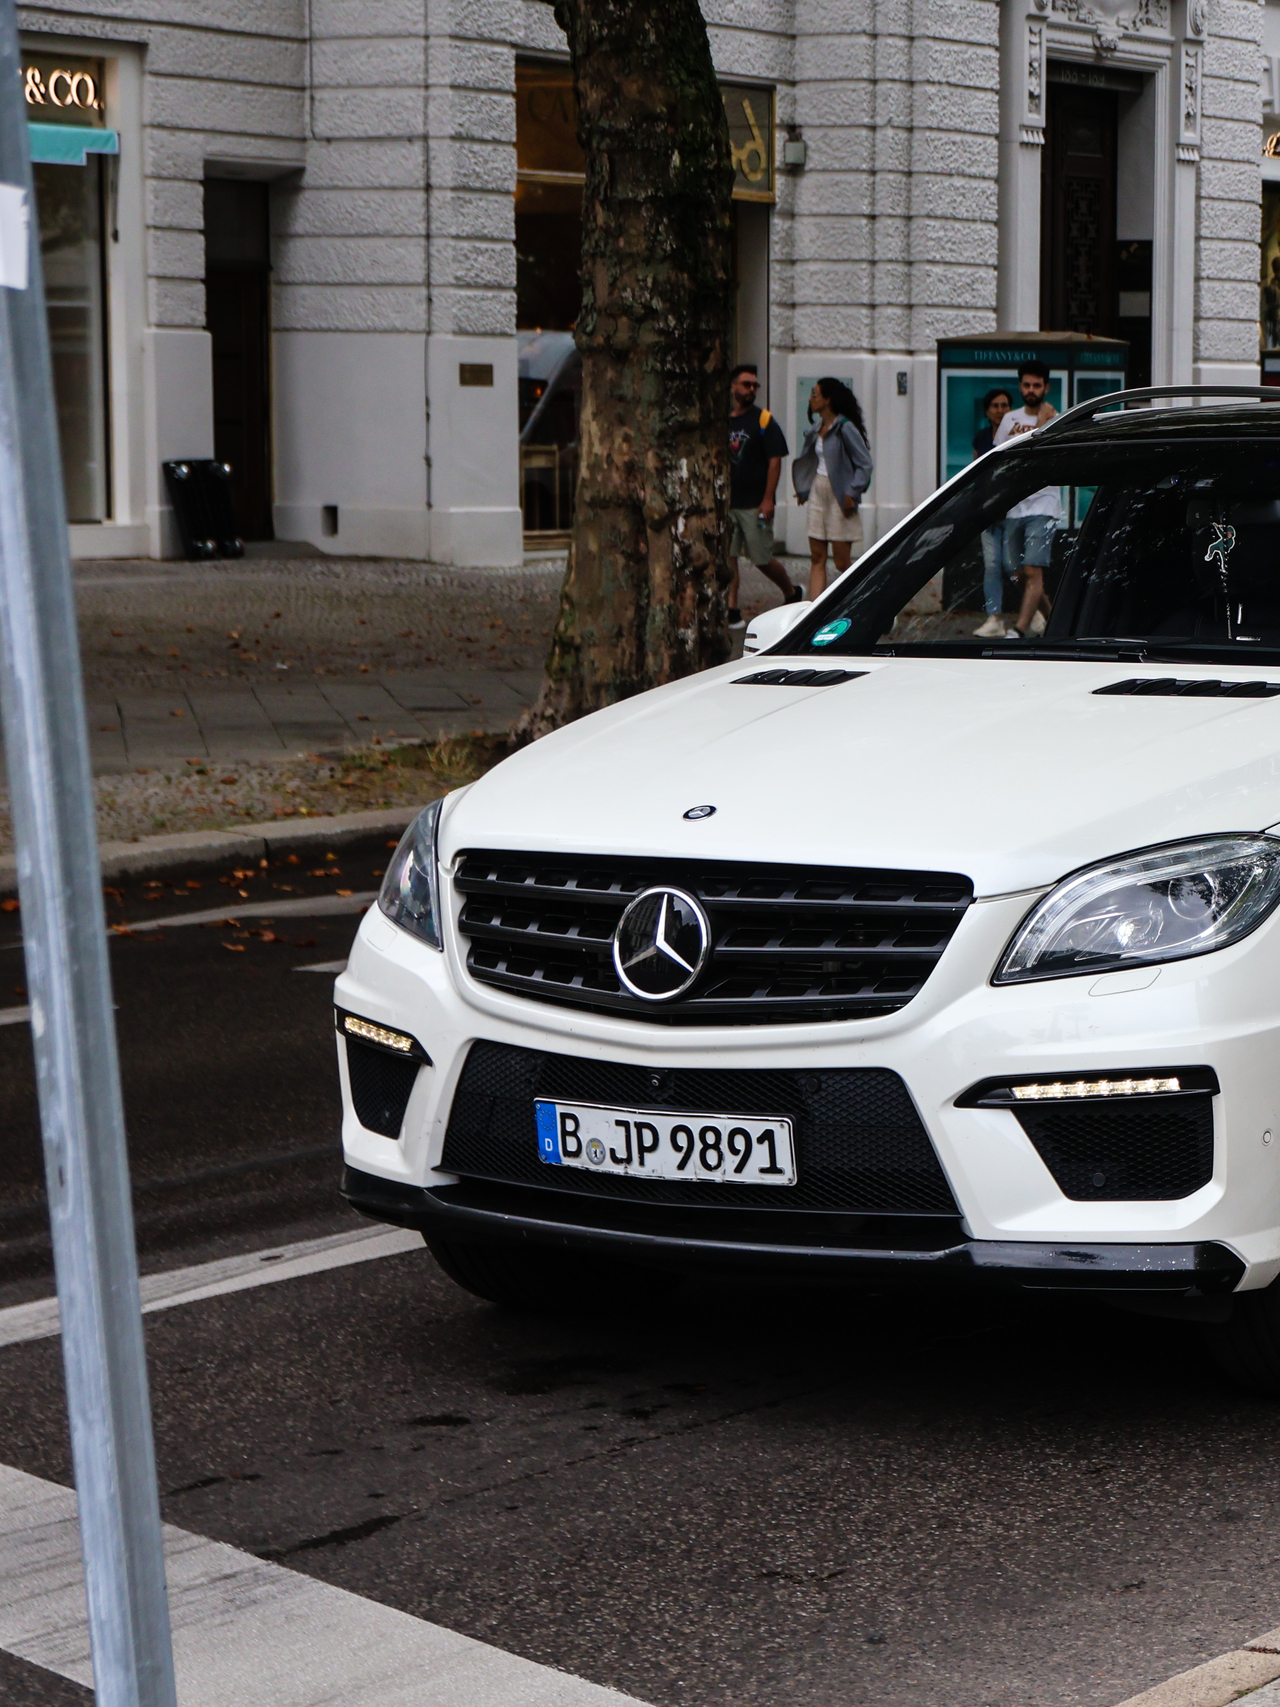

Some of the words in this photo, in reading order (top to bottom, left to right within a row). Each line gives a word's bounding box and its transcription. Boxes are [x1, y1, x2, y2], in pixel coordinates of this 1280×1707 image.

[544, 1138, 554, 1152] D
[559, 1112, 583, 1159] B
[609, 1119, 660, 1167] JP
[669, 1123, 786, 1175] 9891
